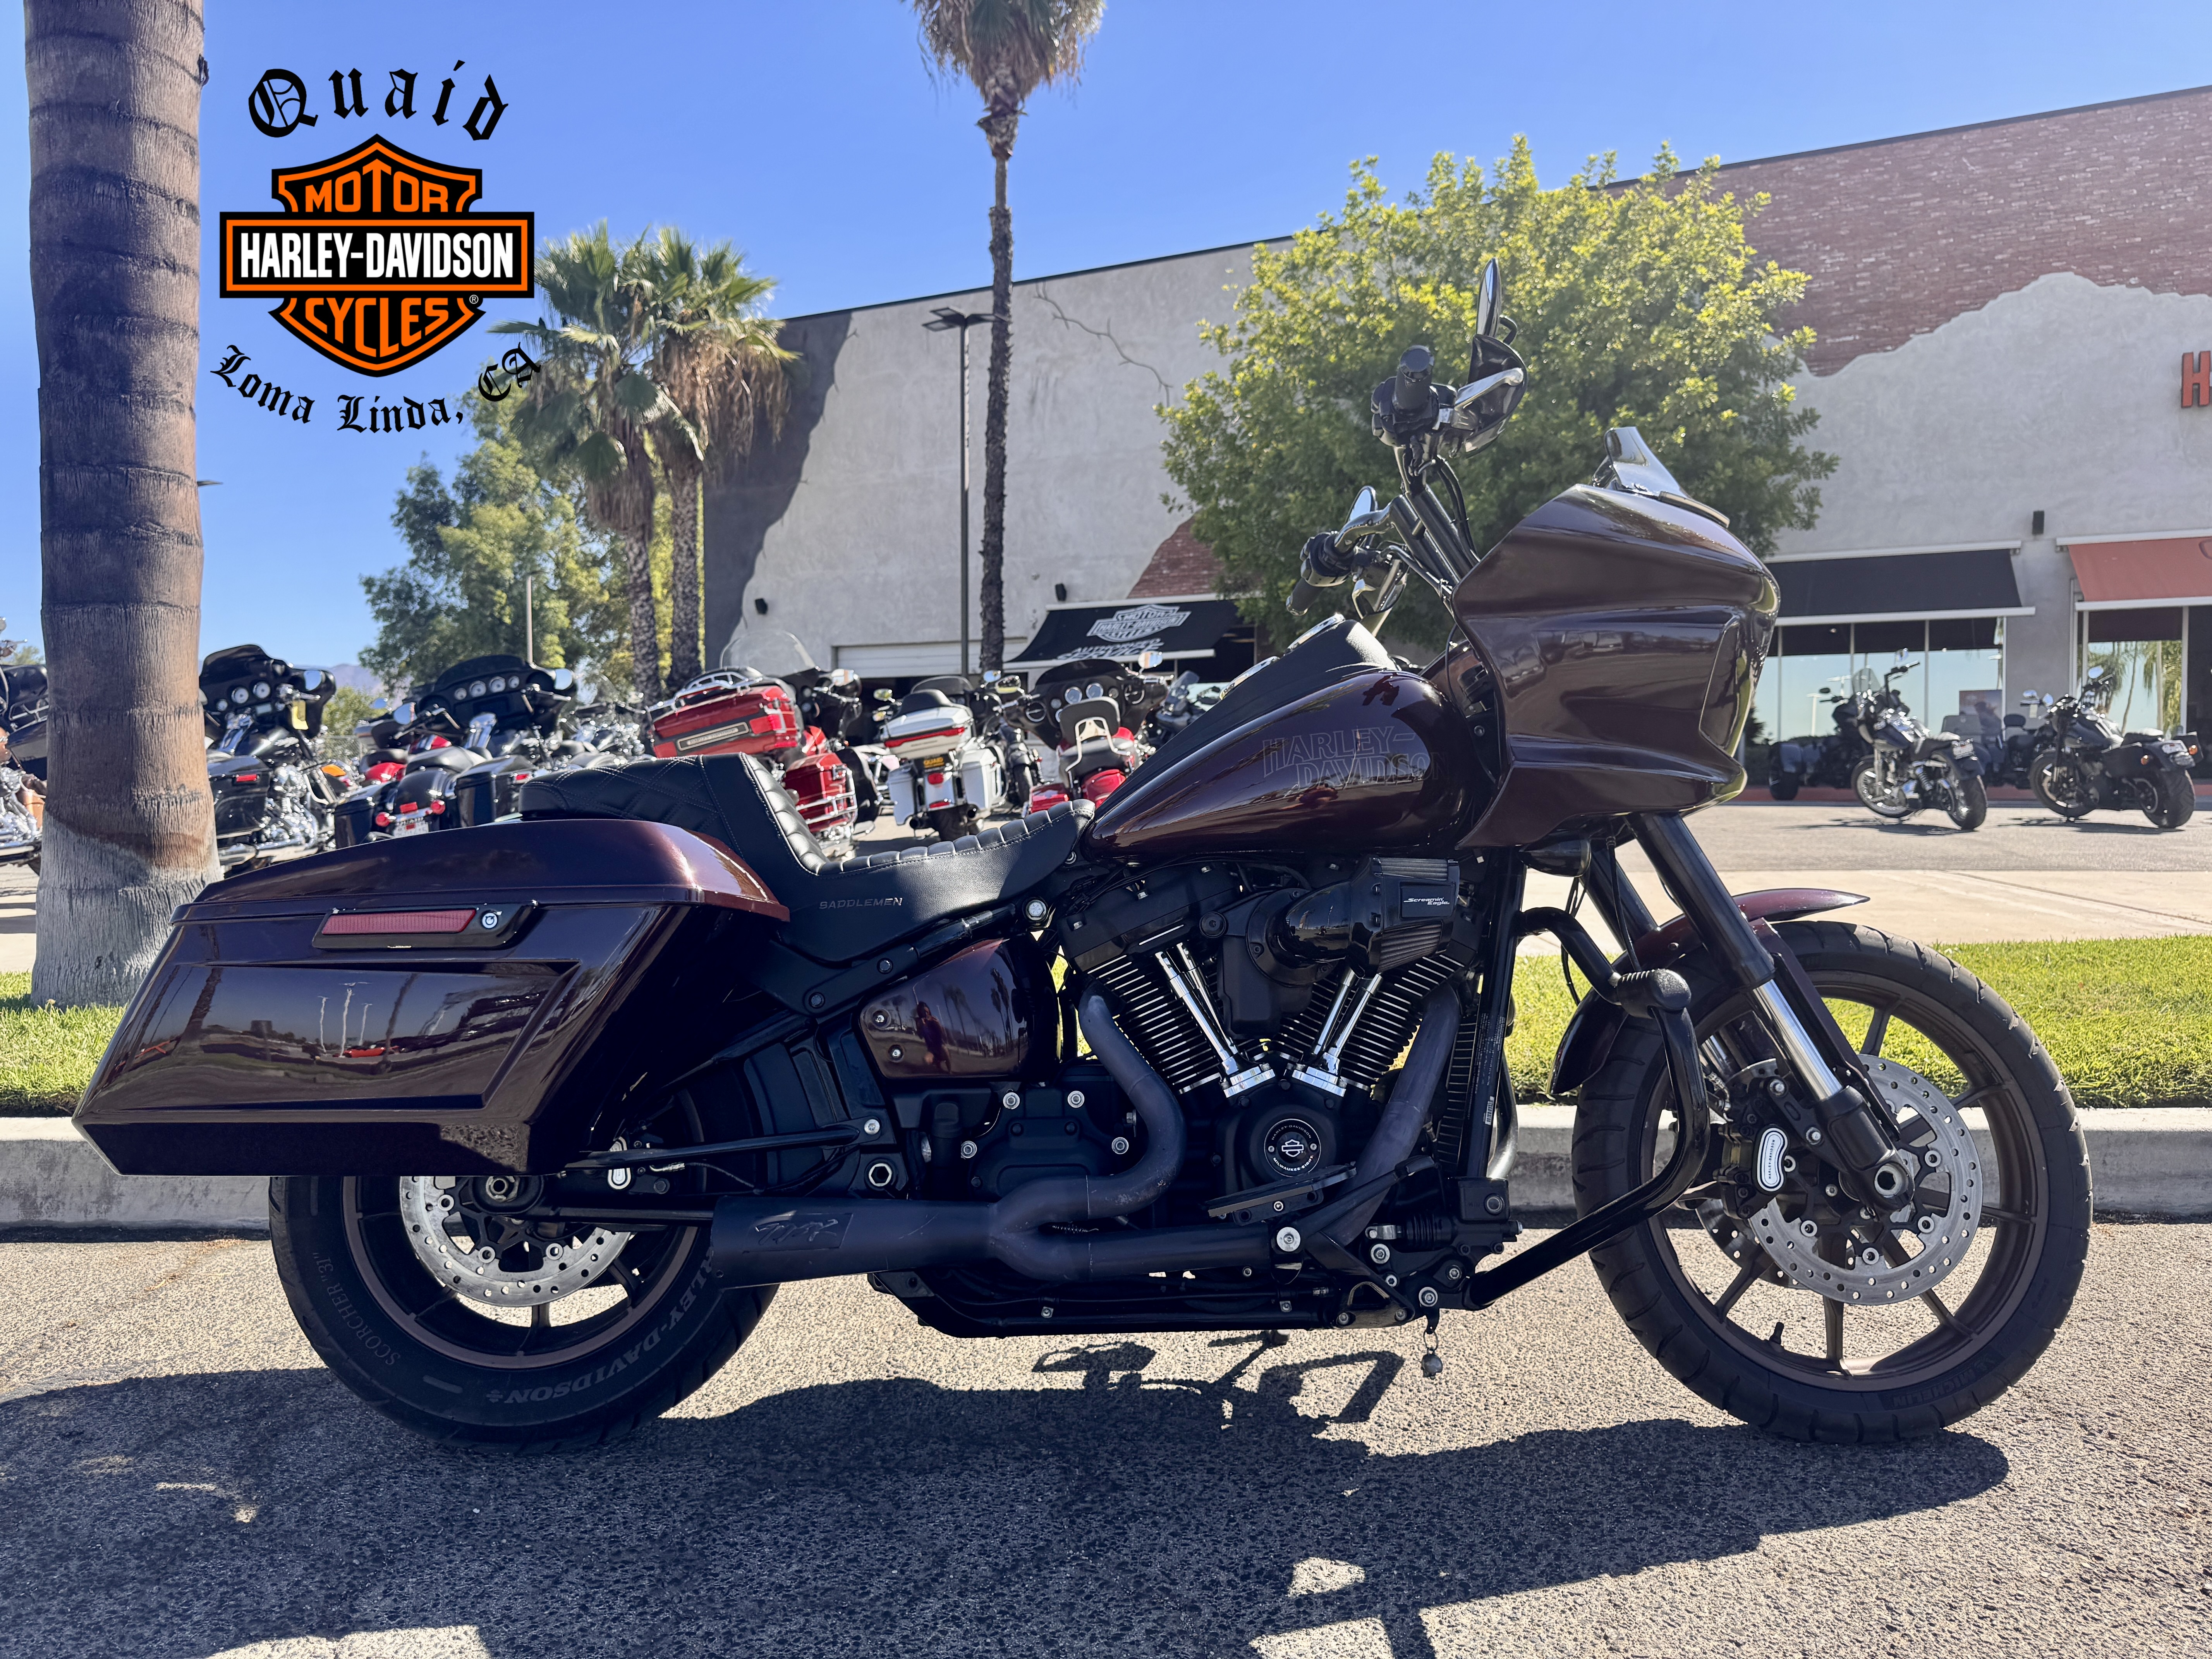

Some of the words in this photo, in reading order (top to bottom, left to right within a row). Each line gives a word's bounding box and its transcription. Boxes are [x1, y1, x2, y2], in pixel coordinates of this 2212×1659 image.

[1099, 617, 1176, 631] HARLEY-DAVIDSON
[1295, 752, 1450, 789] DAVIDSON
[819, 897, 903, 909] SADDLEMEN
[326, 1282, 401, 1365] SCORCHER
[1892, 1369, 1976, 1407] MICHELIN
